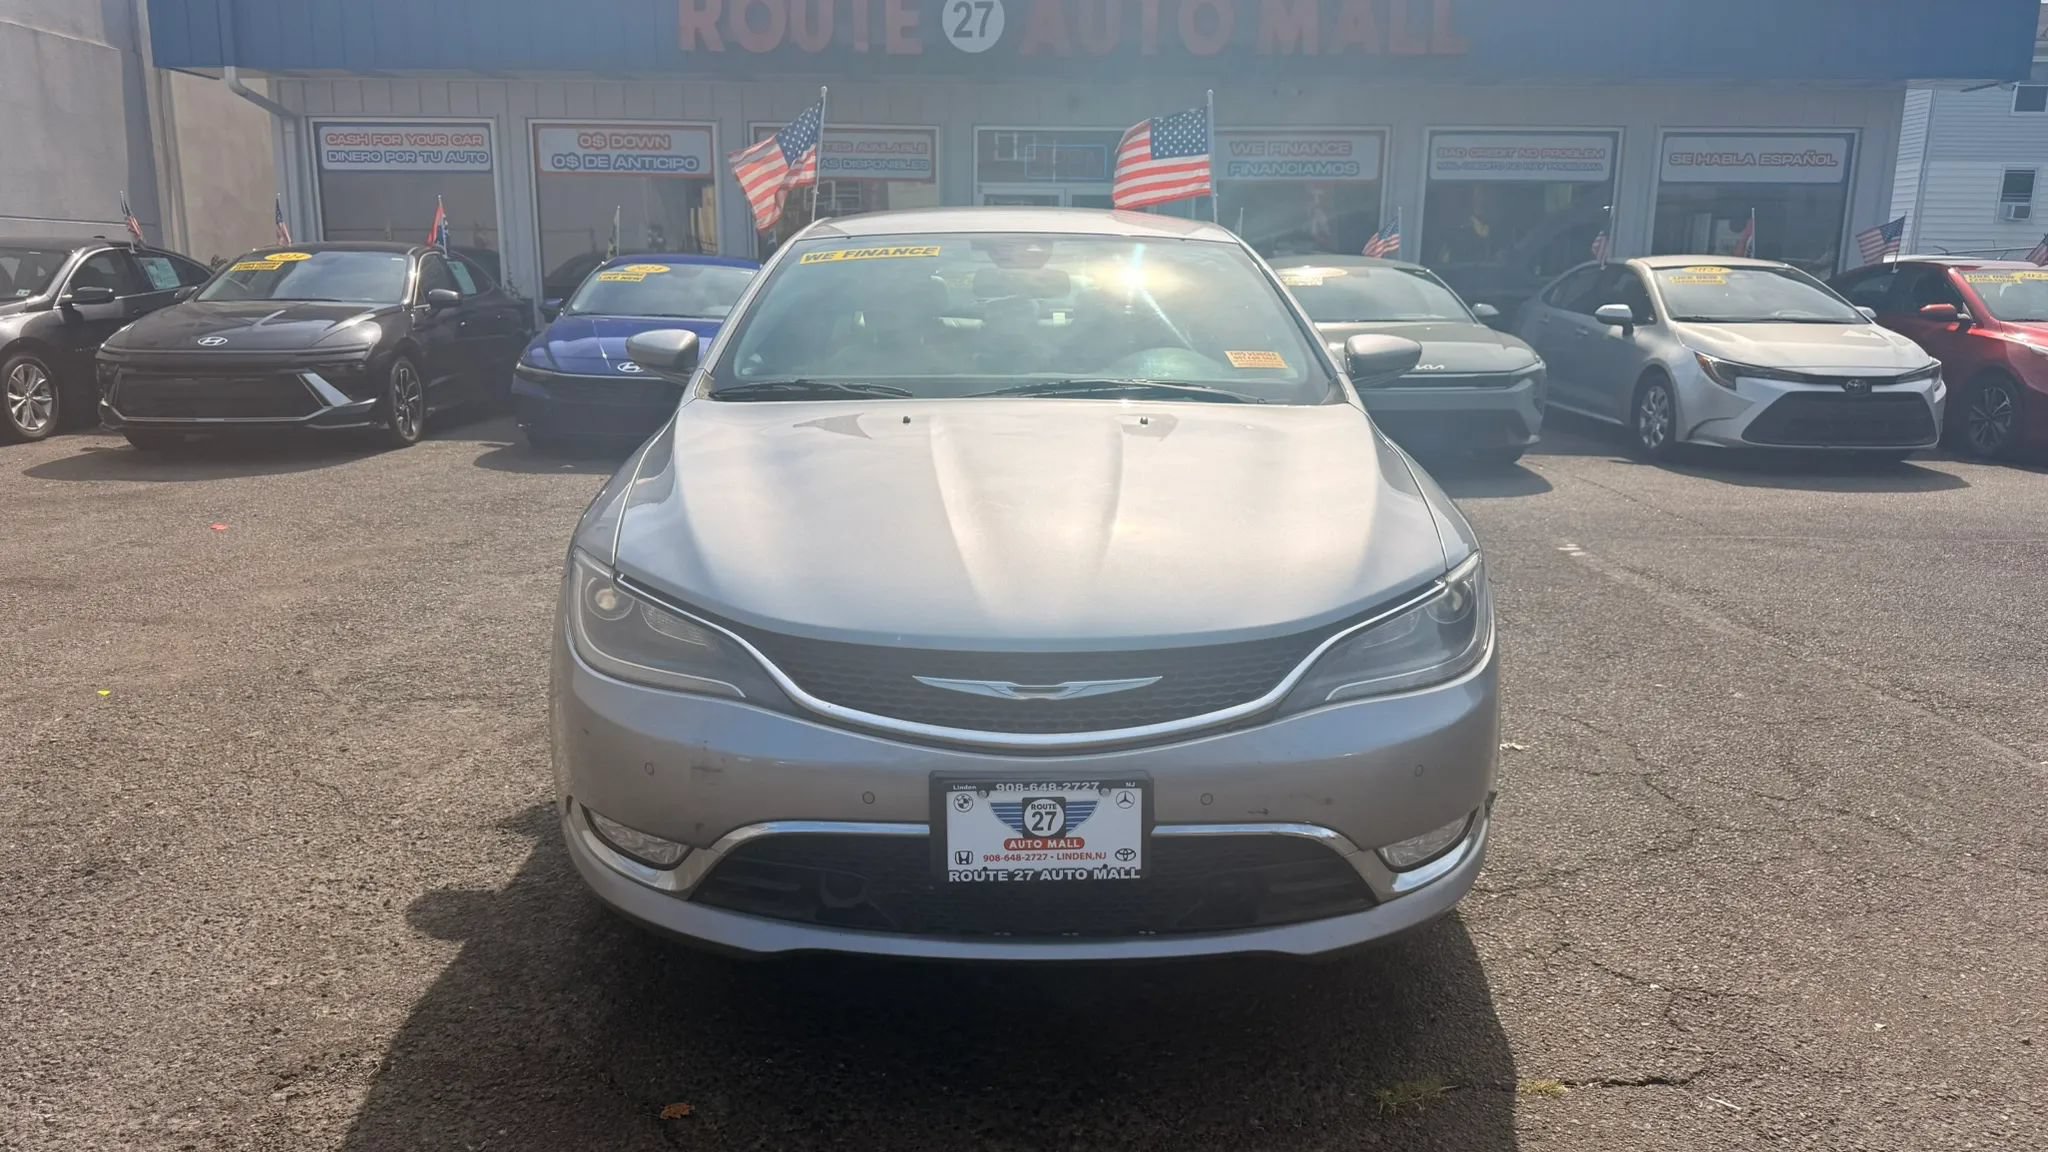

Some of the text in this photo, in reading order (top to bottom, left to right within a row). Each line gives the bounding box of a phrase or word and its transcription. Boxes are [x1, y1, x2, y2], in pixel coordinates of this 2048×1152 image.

[952, 1, 996, 38] 27
[326, 133, 483, 147] CASH FOR YOUR CAR
[610, 133, 671, 150] DOWN
[1229, 140, 1353, 157] WE FINANCE
[327, 150, 488, 163] DINERO POR TU AUTO
[583, 154, 611, 169] DE
[613, 155, 700, 171] ANTICIPO
[1669, 150, 1839, 168] SE HABLA ESPAÑOL
[1228, 160, 1360, 176] FINANCIAMOS
[805, 247, 938, 262] WE FINANCE
[995, 782, 1100, 793] 908-648-2727
[1031, 811, 1057, 831] 27
[1009, 838, 1080, 849] AUTO MALL
[983, 853, 1048, 862] 908-648-2727
[949, 867, 1141, 882] ROUTE 27 AUTO MALL
